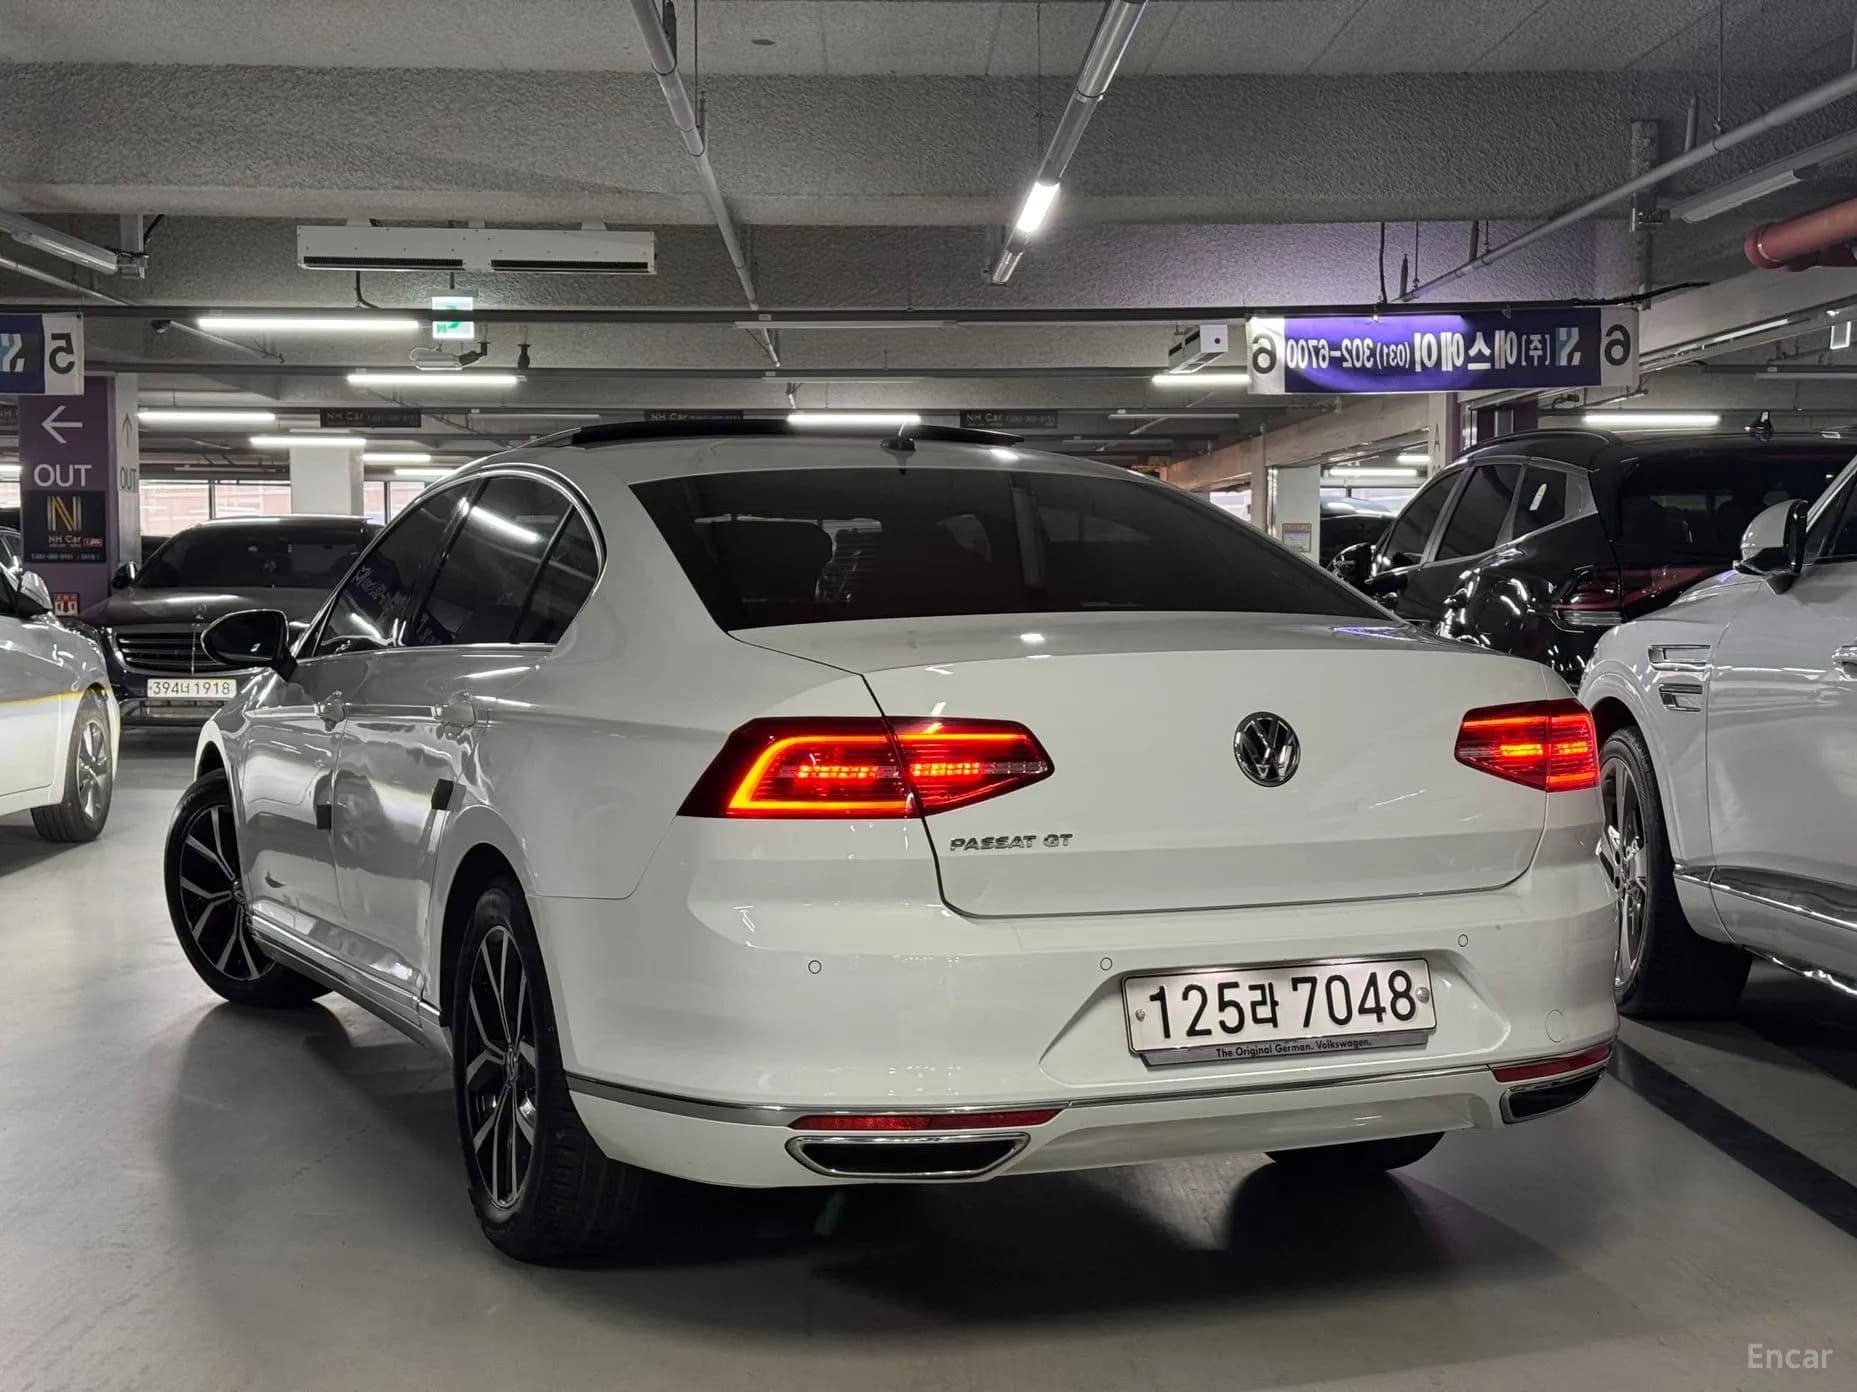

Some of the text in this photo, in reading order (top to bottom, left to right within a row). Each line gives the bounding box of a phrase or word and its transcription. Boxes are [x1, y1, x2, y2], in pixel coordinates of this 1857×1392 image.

[34, 463, 92, 487] OUT
[120, 466, 137, 490] OUT
[194, 681, 231, 695] 1918
[950, 833, 1074, 851] PASSAT GT
[1149, 969, 1417, 1039] 125라 7048
[1215, 1048, 1233, 1059] The
[1235, 1044, 1273, 1058] Original
[1274, 1043, 1314, 1055] German.
